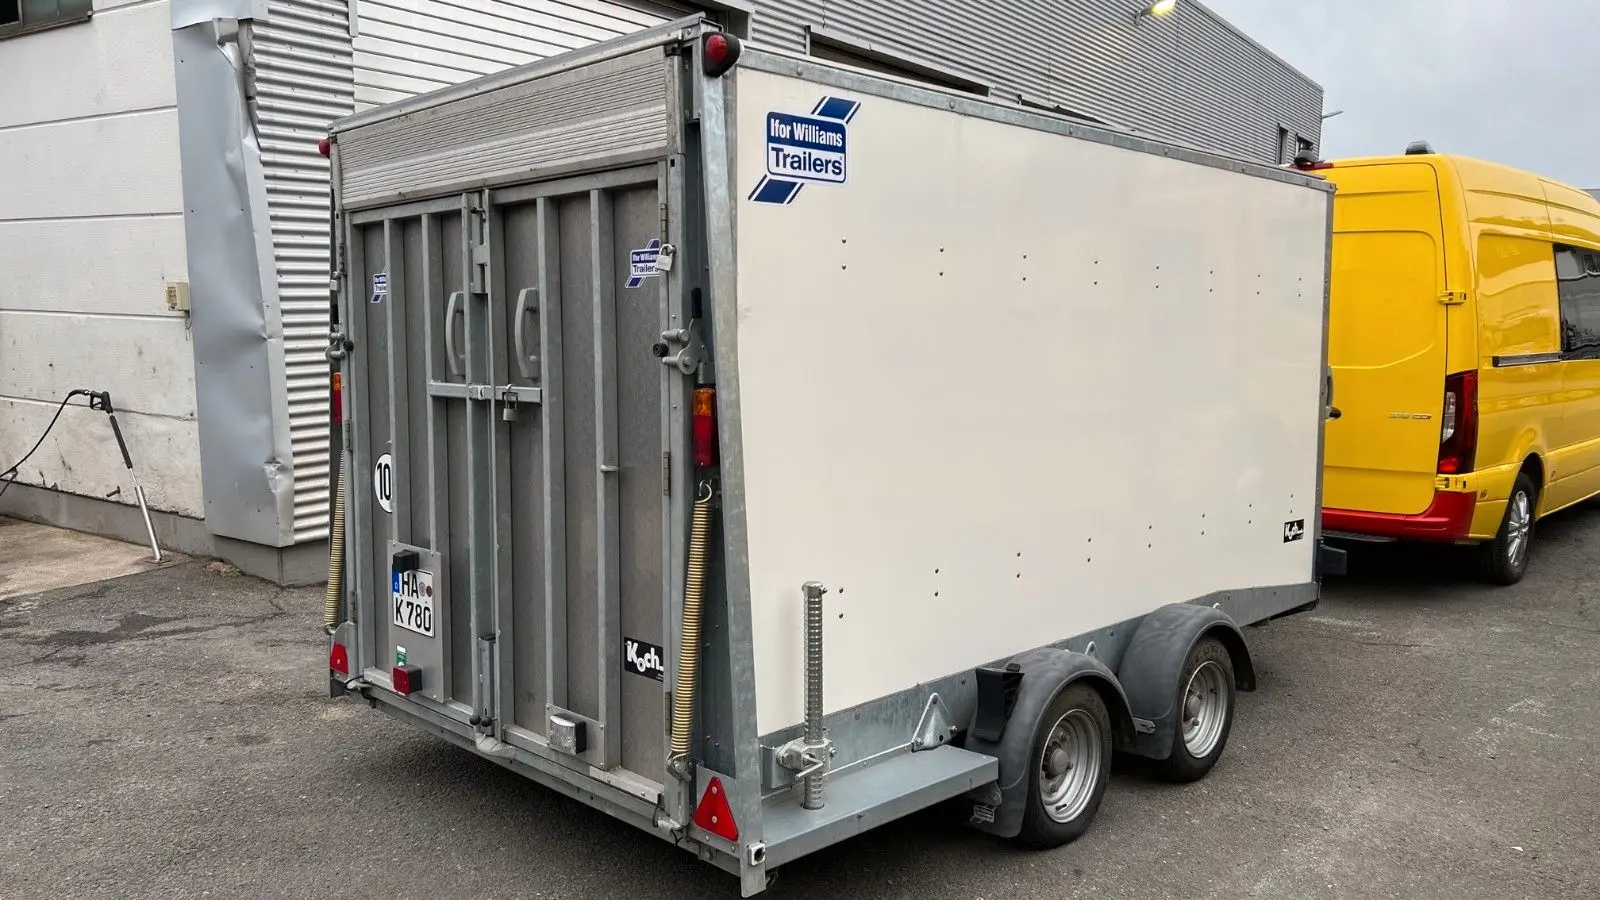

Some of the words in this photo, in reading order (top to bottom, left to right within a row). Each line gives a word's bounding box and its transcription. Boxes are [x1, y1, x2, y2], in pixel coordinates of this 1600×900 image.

[770, 118, 792, 140] Ifor
[793, 121, 843, 147] Williams
[771, 146, 843, 176] Trailers
[640, 253, 657, 261] William
[377, 462, 392, 501] 10
[402, 572, 419, 599] HA
[395, 597, 404, 624] K
[406, 601, 432, 632] 780
